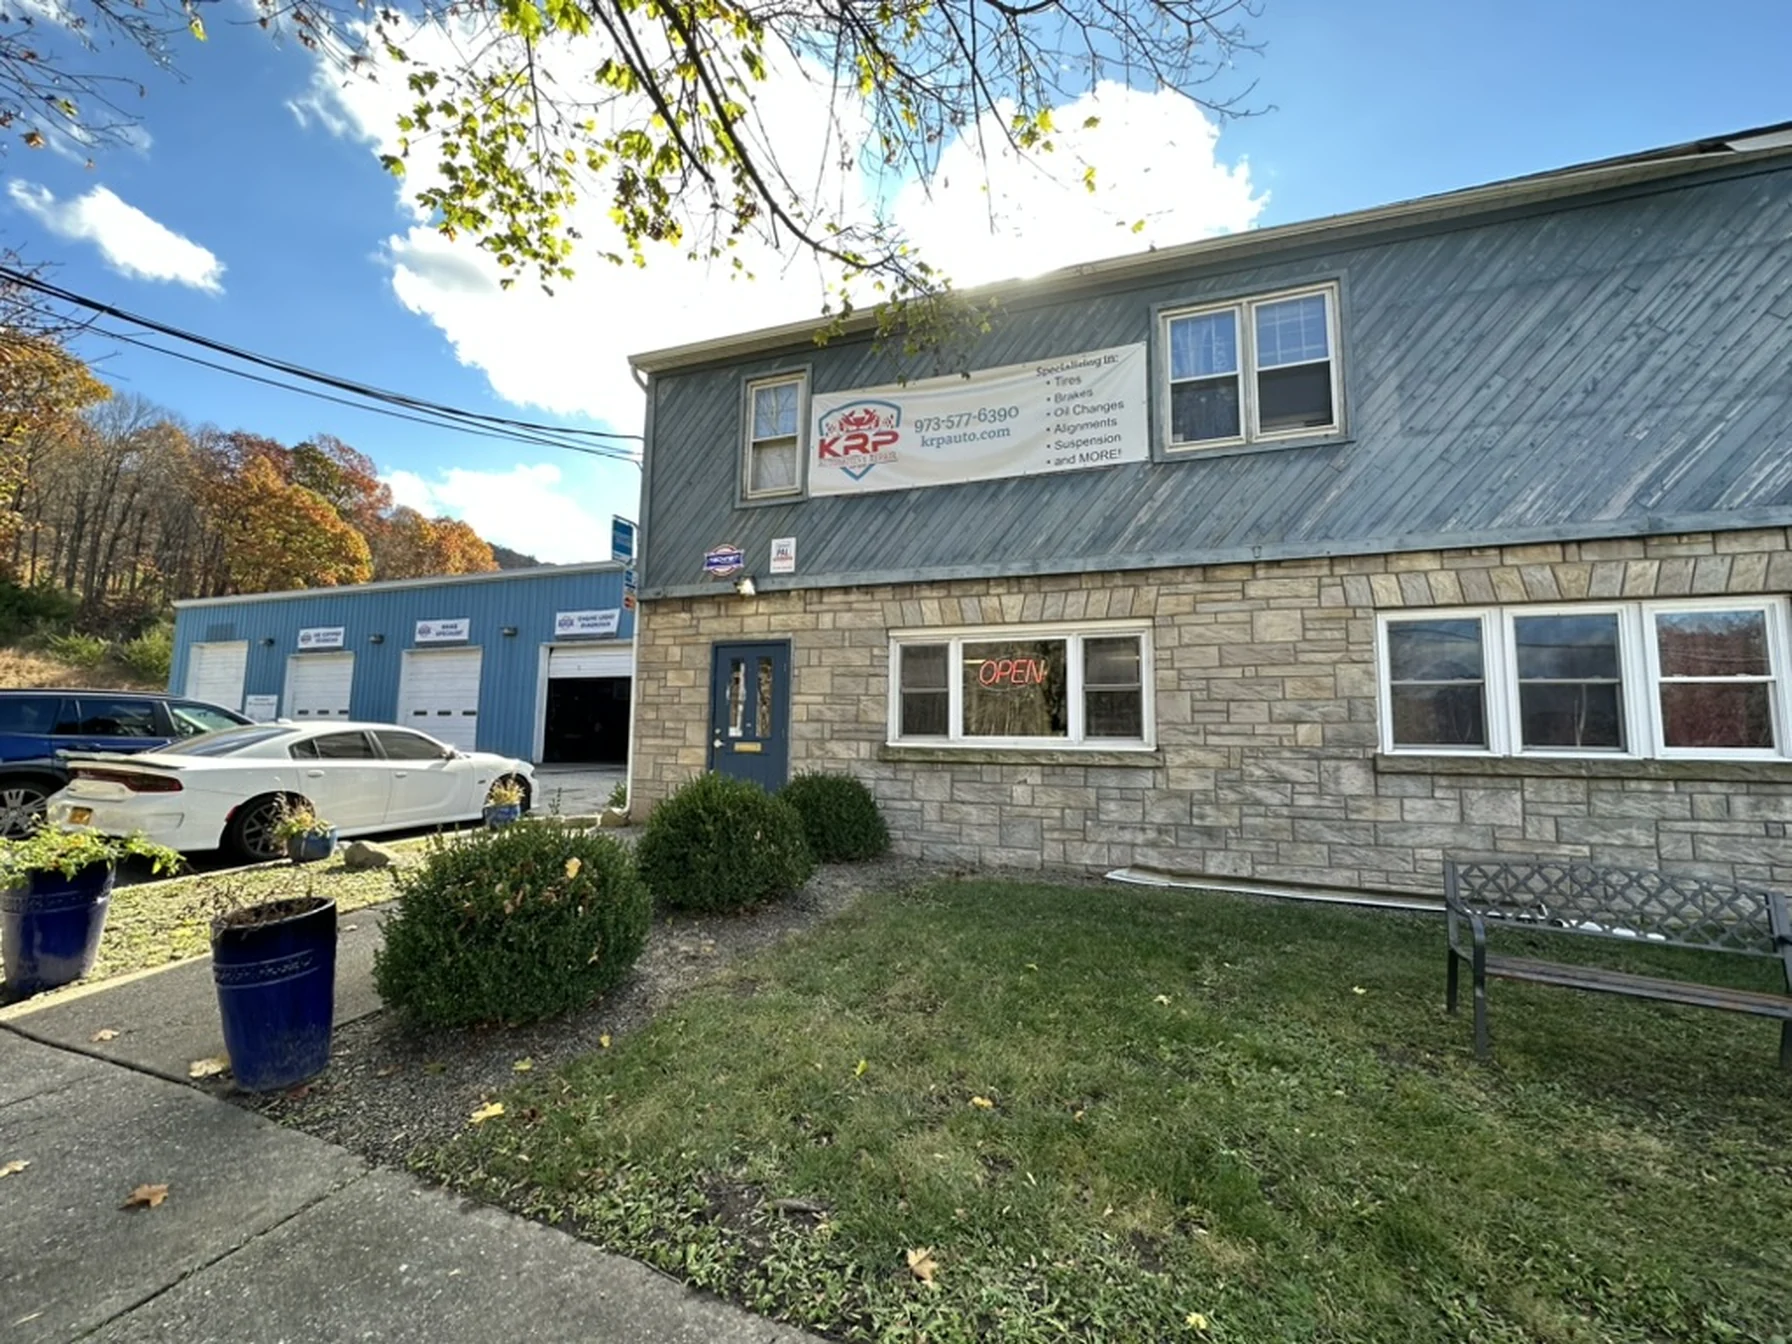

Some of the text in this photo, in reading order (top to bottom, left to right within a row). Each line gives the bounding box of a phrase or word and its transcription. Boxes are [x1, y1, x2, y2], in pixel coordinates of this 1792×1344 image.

[1054, 376, 1082, 387] Tires
[1054, 389, 1093, 404] Brakes
[1054, 400, 1124, 417] Oil Changes
[914, 405, 1020, 433] 973-577-6390
[1054, 418, 1118, 435] Alignments
[818, 430, 900, 460] KRP
[920, 426, 1011, 449] krpauto.com
[1054, 434, 1122, 451] Suspension
[1054, 448, 1122, 466] and MORE!
[979, 658, 1047, 685] OPEN
